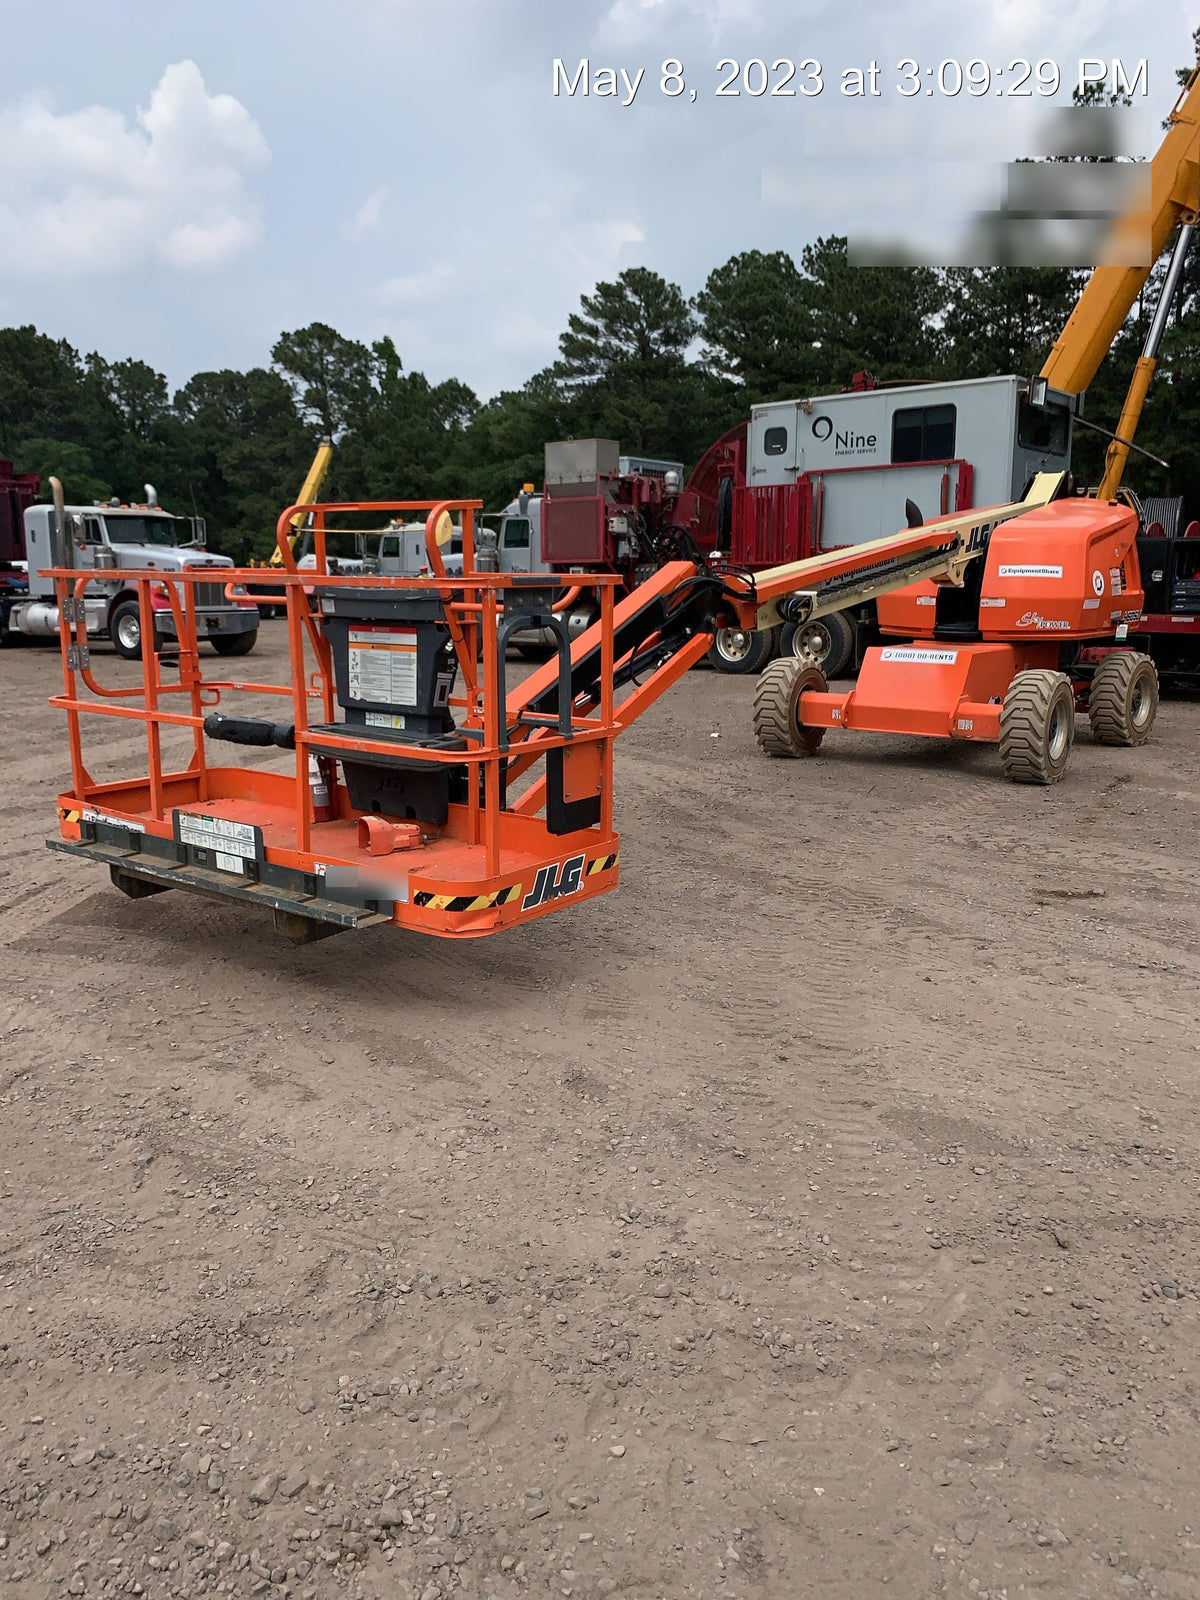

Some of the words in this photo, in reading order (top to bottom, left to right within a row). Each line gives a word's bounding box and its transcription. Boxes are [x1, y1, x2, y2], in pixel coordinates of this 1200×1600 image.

[835, 431, 877, 450] Nine
[964, 522, 992, 554] JLG
[1007, 567, 1060, 575] EquipmentShare
[521, 854, 586, 911] JLG
